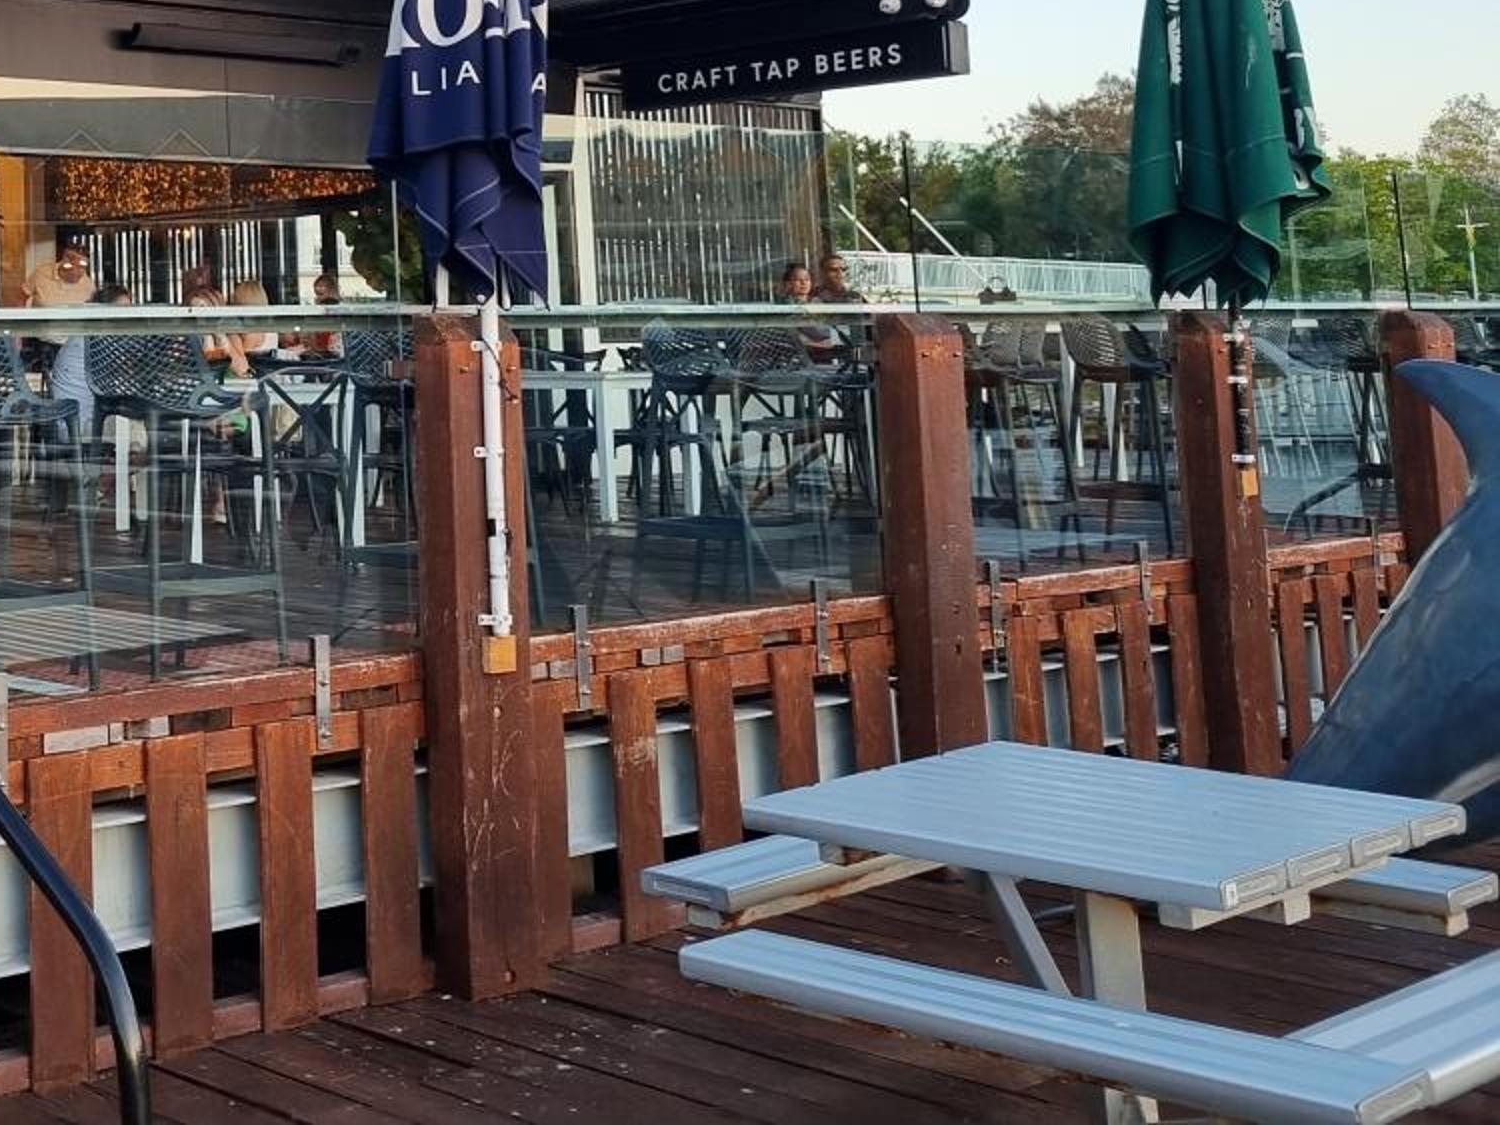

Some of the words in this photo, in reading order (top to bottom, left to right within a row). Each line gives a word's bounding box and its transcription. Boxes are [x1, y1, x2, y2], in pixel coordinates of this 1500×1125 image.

[657, 65, 737, 94] CRAFT
[751, 58, 800, 82] TAP
[814, 43, 902, 75] BEERS
